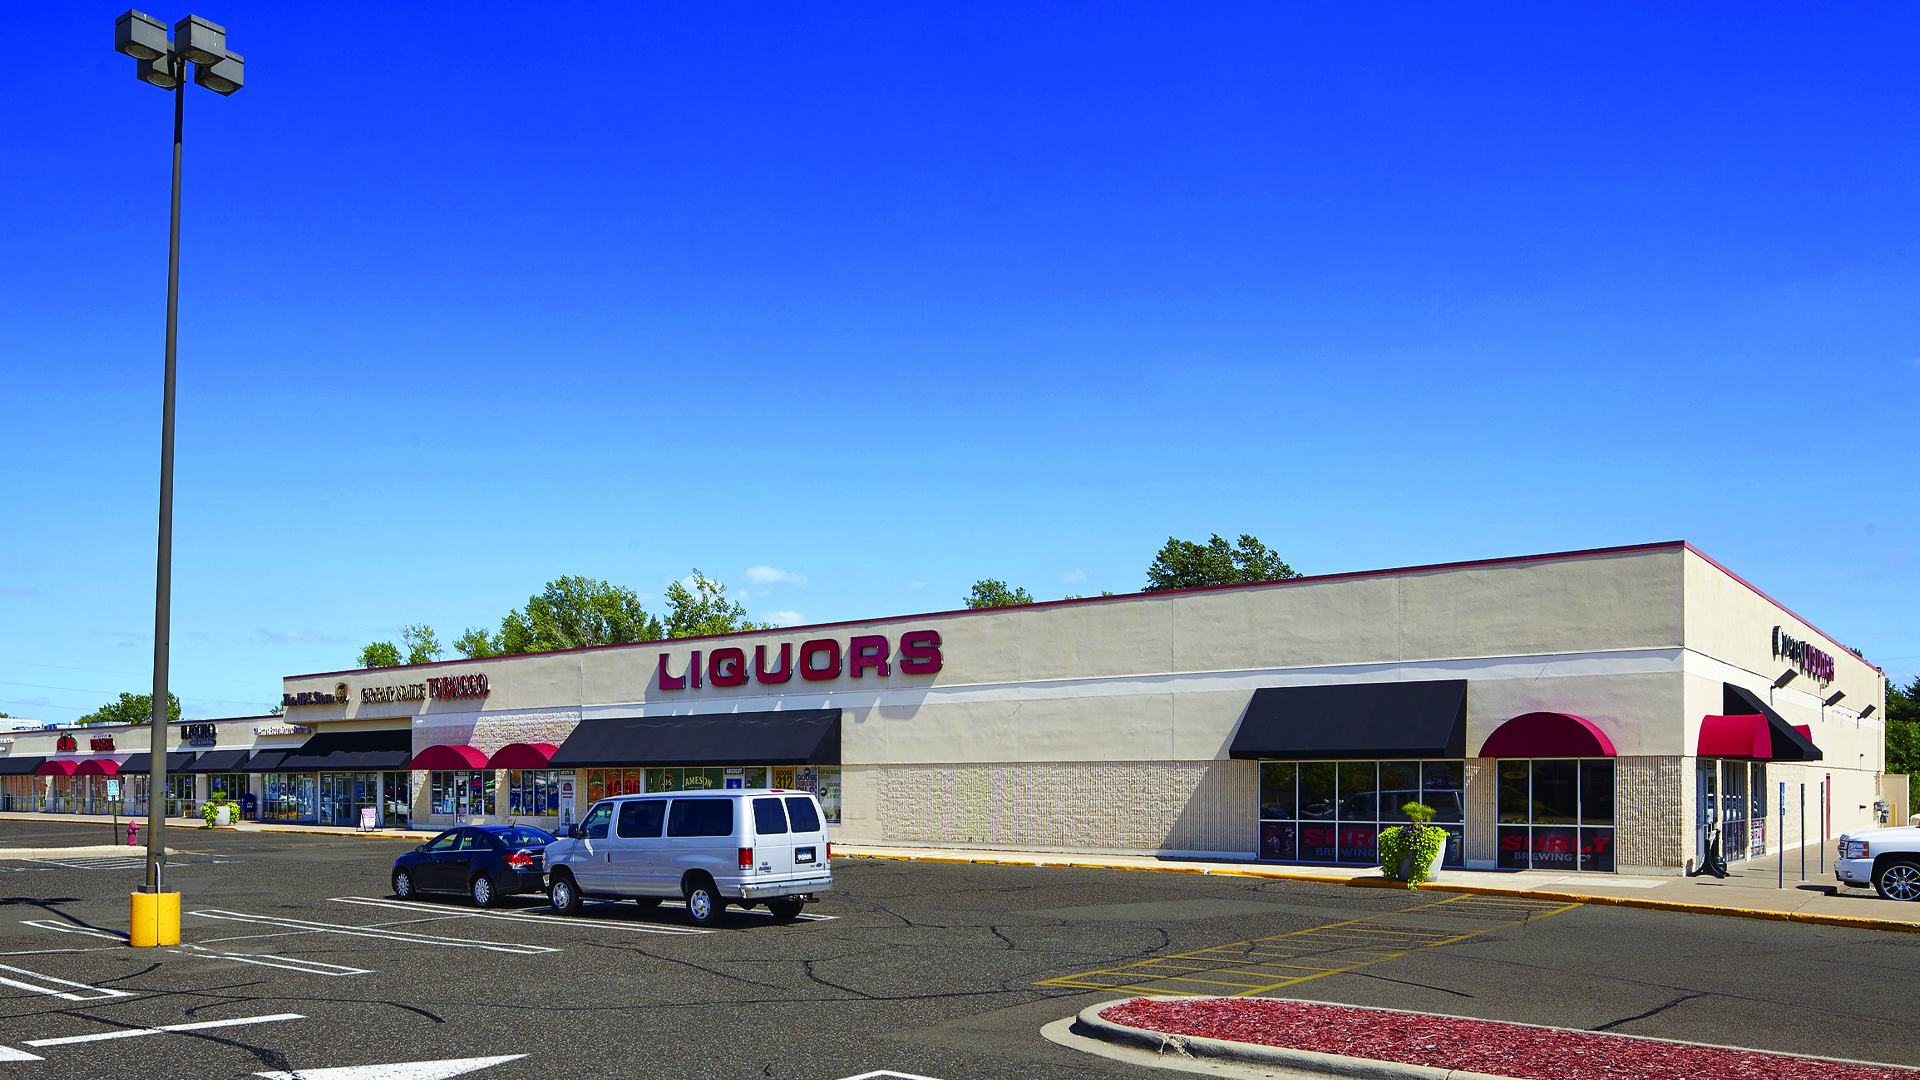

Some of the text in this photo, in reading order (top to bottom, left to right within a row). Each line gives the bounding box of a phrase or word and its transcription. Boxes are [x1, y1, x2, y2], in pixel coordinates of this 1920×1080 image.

[659, 630, 944, 690] LIQUORS
[427, 674, 488, 698] TOBACCO
[283, 691, 335, 706] The UPS Store
[681, 776, 713, 788] AMESON
[775, 776, 793, 789] 312
[1501, 835, 1611, 854] SURLY
[1316, 847, 1376, 858] BREWING
[1514, 852, 1573, 862] BREWING
